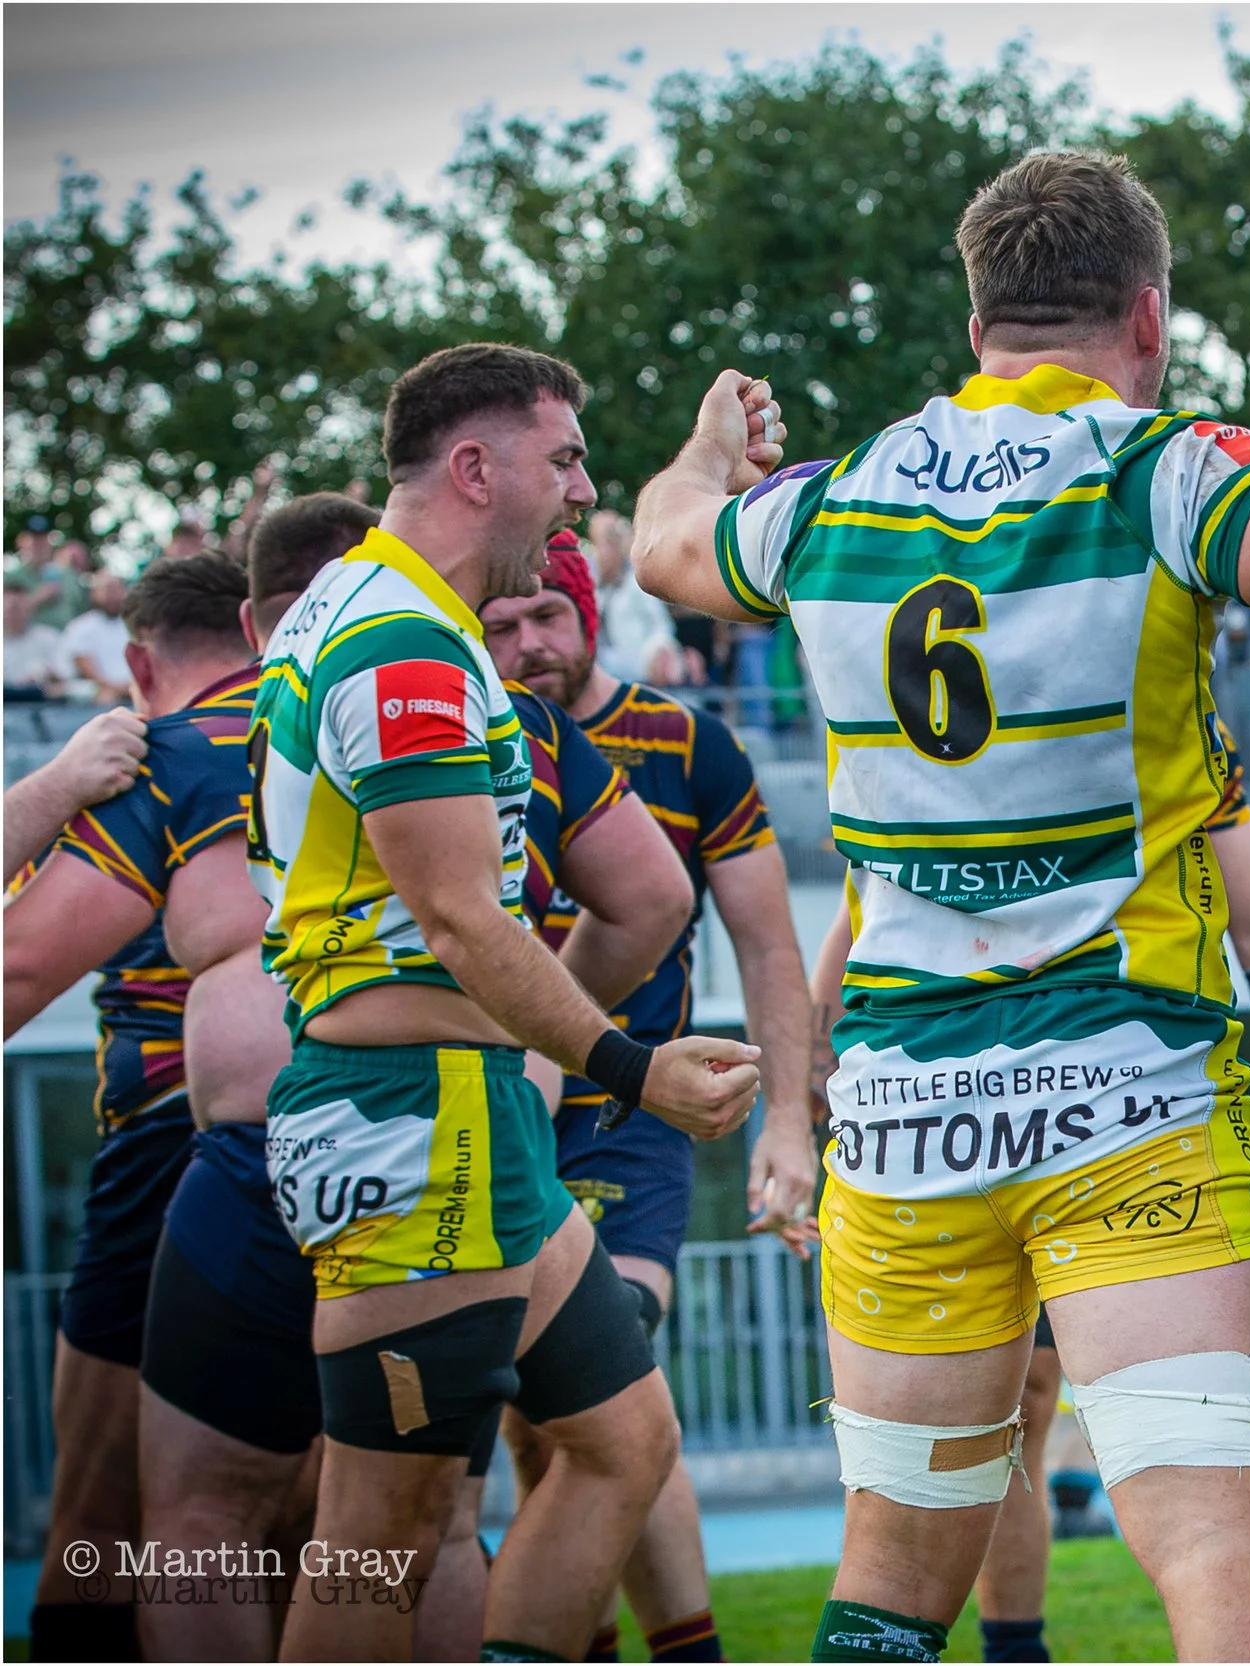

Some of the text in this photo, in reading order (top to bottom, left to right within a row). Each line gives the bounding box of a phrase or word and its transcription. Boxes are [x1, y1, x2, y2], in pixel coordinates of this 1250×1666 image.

[884, 573, 998, 766] 6
[406, 699, 463, 721] FIRESAFE
[856, 1073, 947, 1107] LITTLE
[954, 1068, 1006, 1098] BIG
[1013, 1064, 1114, 1096] BREW
[315, 1175, 388, 1225] UP
